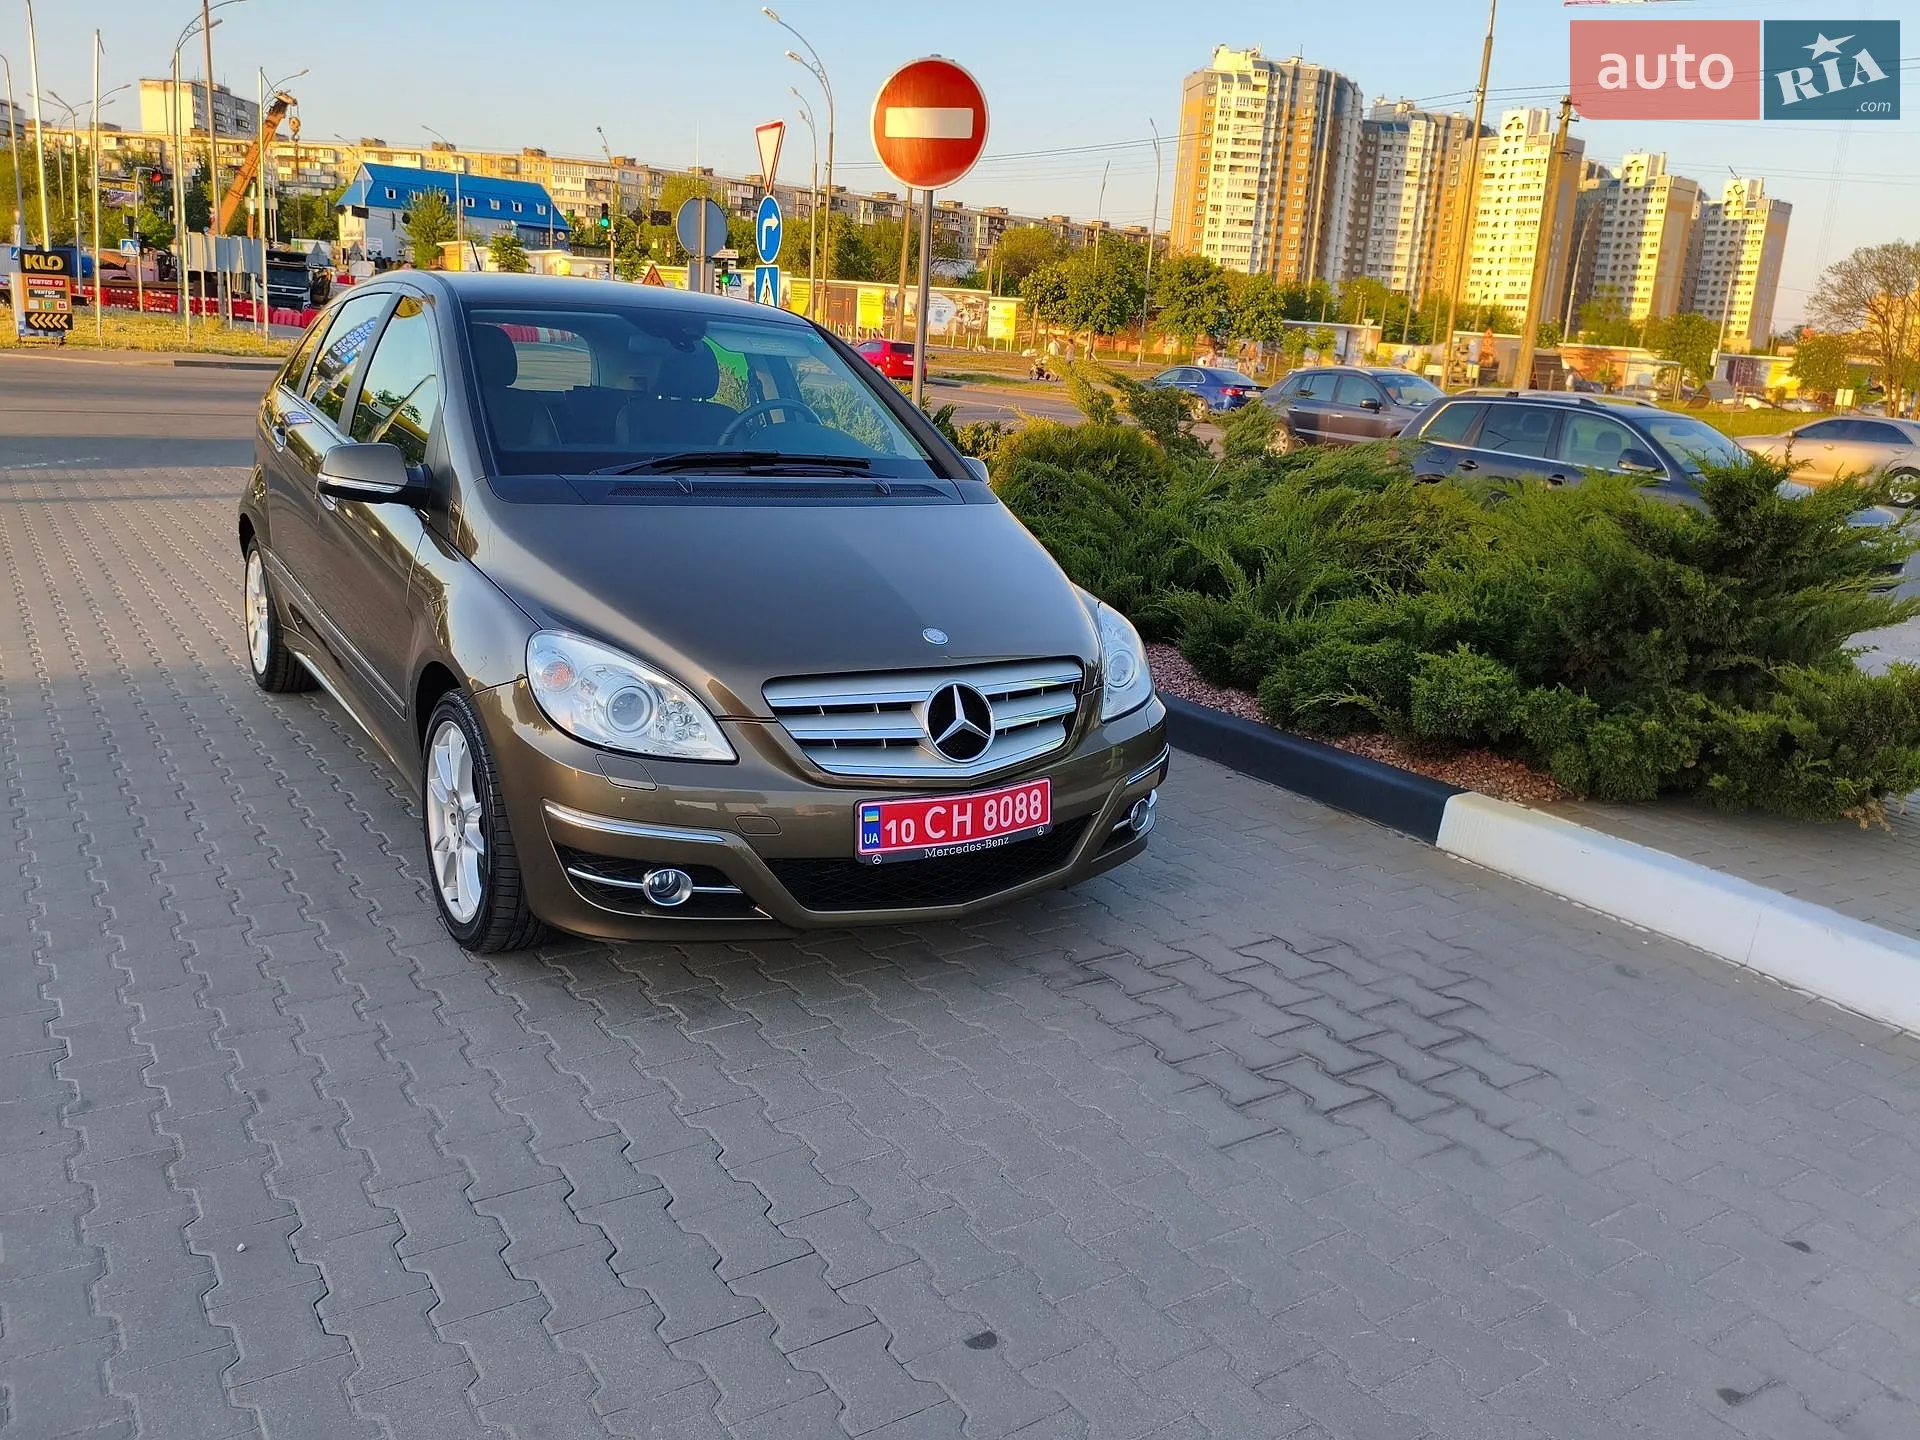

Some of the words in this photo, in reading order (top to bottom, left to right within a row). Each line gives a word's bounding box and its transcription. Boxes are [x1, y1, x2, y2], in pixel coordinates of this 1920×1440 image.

[24, 254, 64, 270] KLO
[884, 818, 916, 845] 10
[924, 802, 973, 839] CH
[983, 789, 1042, 832] 8088
[864, 832, 879, 844] UA
[924, 836, 1010, 859] Mercedes-Benz
